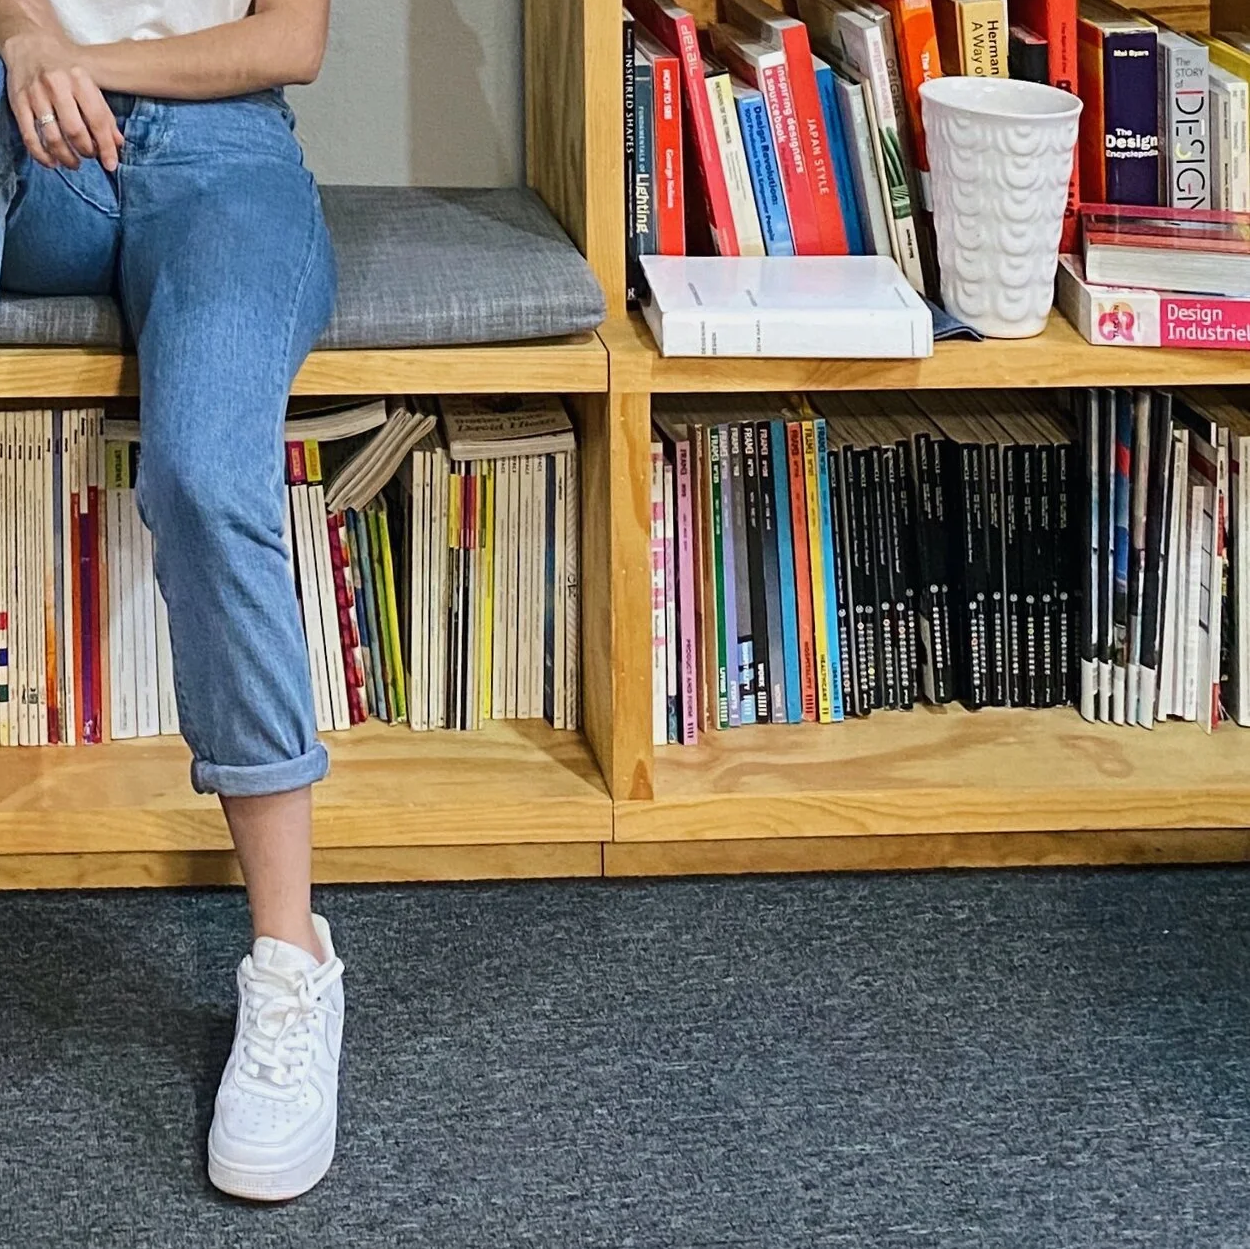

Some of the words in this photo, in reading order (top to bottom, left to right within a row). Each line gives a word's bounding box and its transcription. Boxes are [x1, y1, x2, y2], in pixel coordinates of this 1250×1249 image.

[971, 22, 983, 31] A
[972, 34, 985, 63] Way
[987, 20, 999, 75] Herman
[1175, 57, 1191, 66] The
[624, 54, 634, 109] INSPIRED
[663, 69, 672, 90] HOW
[766, 68, 773, 76] a
[1175, 68, 1204, 78] STORY
[1175, 79, 1184, 89] of
[663, 92, 672, 102] TO
[886, 58, 904, 118] ORIGINS
[768, 79, 786, 144] sourcebook
[776, 65, 793, 115] inspiring
[787, 118, 804, 174] designers
[625, 112, 634, 153] SHAPES
[637, 105, 646, 162] FUNDAMENTALS
[745, 125, 758, 158] Products
[807, 118, 822, 155] JAPAN
[1106, 135, 1158, 149] Design
[1116, 128, 1132, 136] The
[664, 148, 674, 178] George
[752, 160, 762, 178] That
[754, 106, 768, 142] Design
[761, 145, 779, 205] Revolution:
[1106, 150, 1158, 158] Encyclopedia
[814, 159, 829, 195] STYLE
[635, 173, 650, 234] Lighting
[756, 179, 768, 214] Empower
[763, 215, 775, 242] People
[1167, 304, 1223, 320] Design
[685, 639, 693, 674] PRODUCT
[804, 641, 812, 689] HOSPITALITY
[757, 663, 765, 687] WORK
